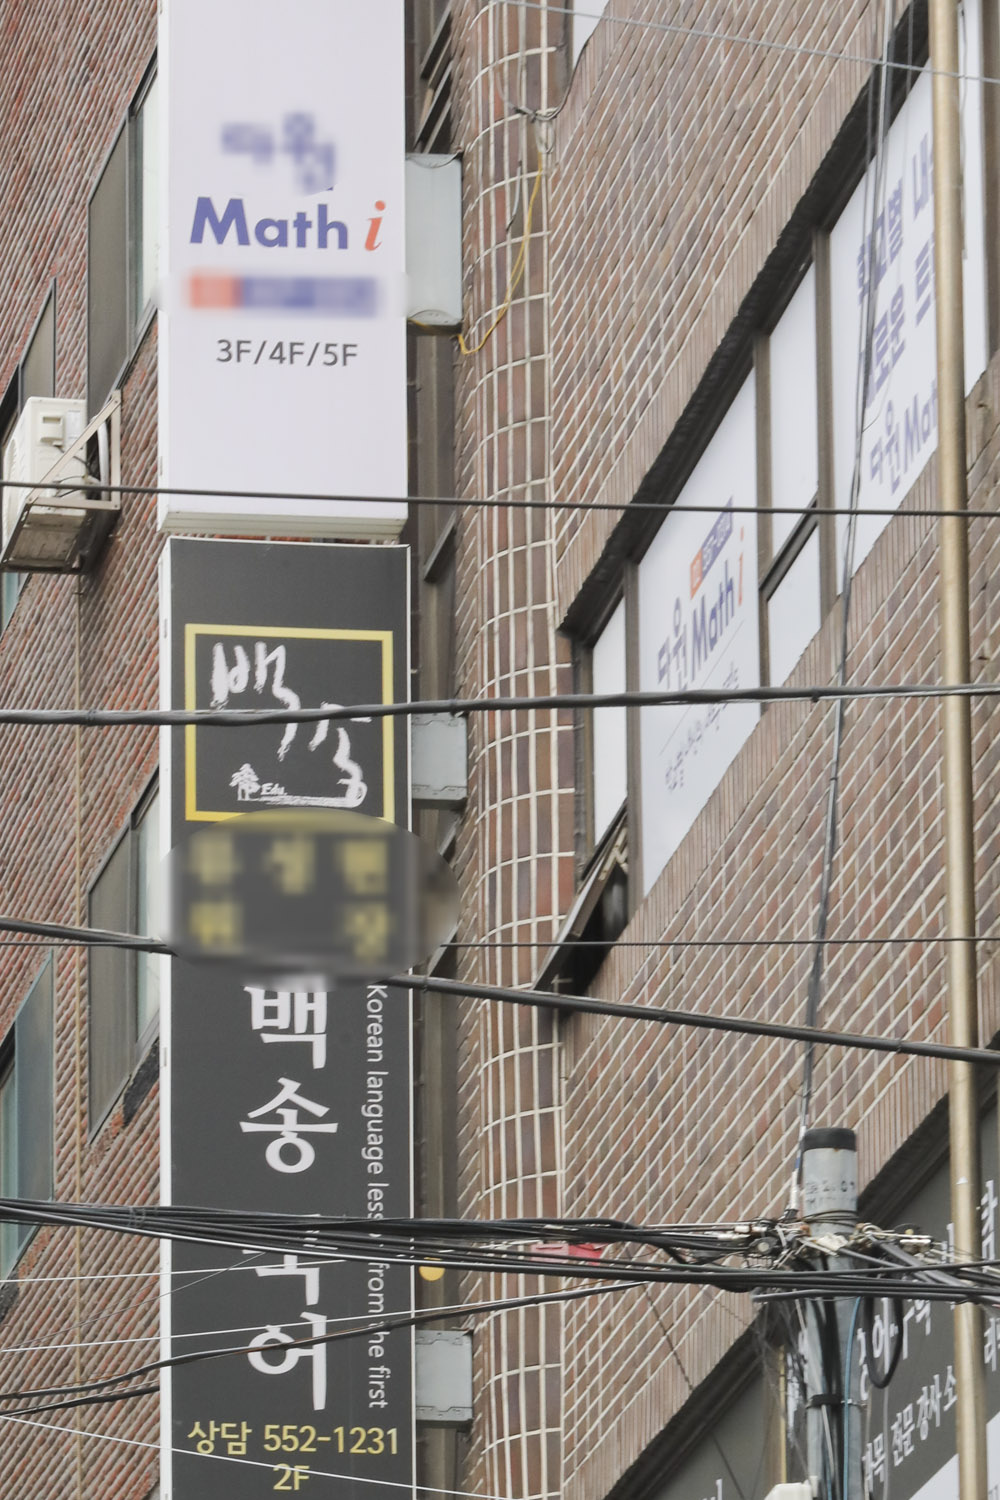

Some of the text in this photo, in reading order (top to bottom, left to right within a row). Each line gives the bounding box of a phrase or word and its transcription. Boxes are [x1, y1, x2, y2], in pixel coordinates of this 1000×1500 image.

[190, 196, 386, 251] Math i
[216, 339, 358, 366] 3F/4F/5F
[691, 559, 734, 683] Math
[366, 985, 389, 1063] Korean
[361, 1072, 389, 1175] language
[366, 1182, 390, 1248] less
[367, 1261, 391, 1315] from
[368, 1366, 391, 1409] first
[187, 1421, 398, 1455] 상담 552-1231
[273, 1464, 310, 1490] 2F
